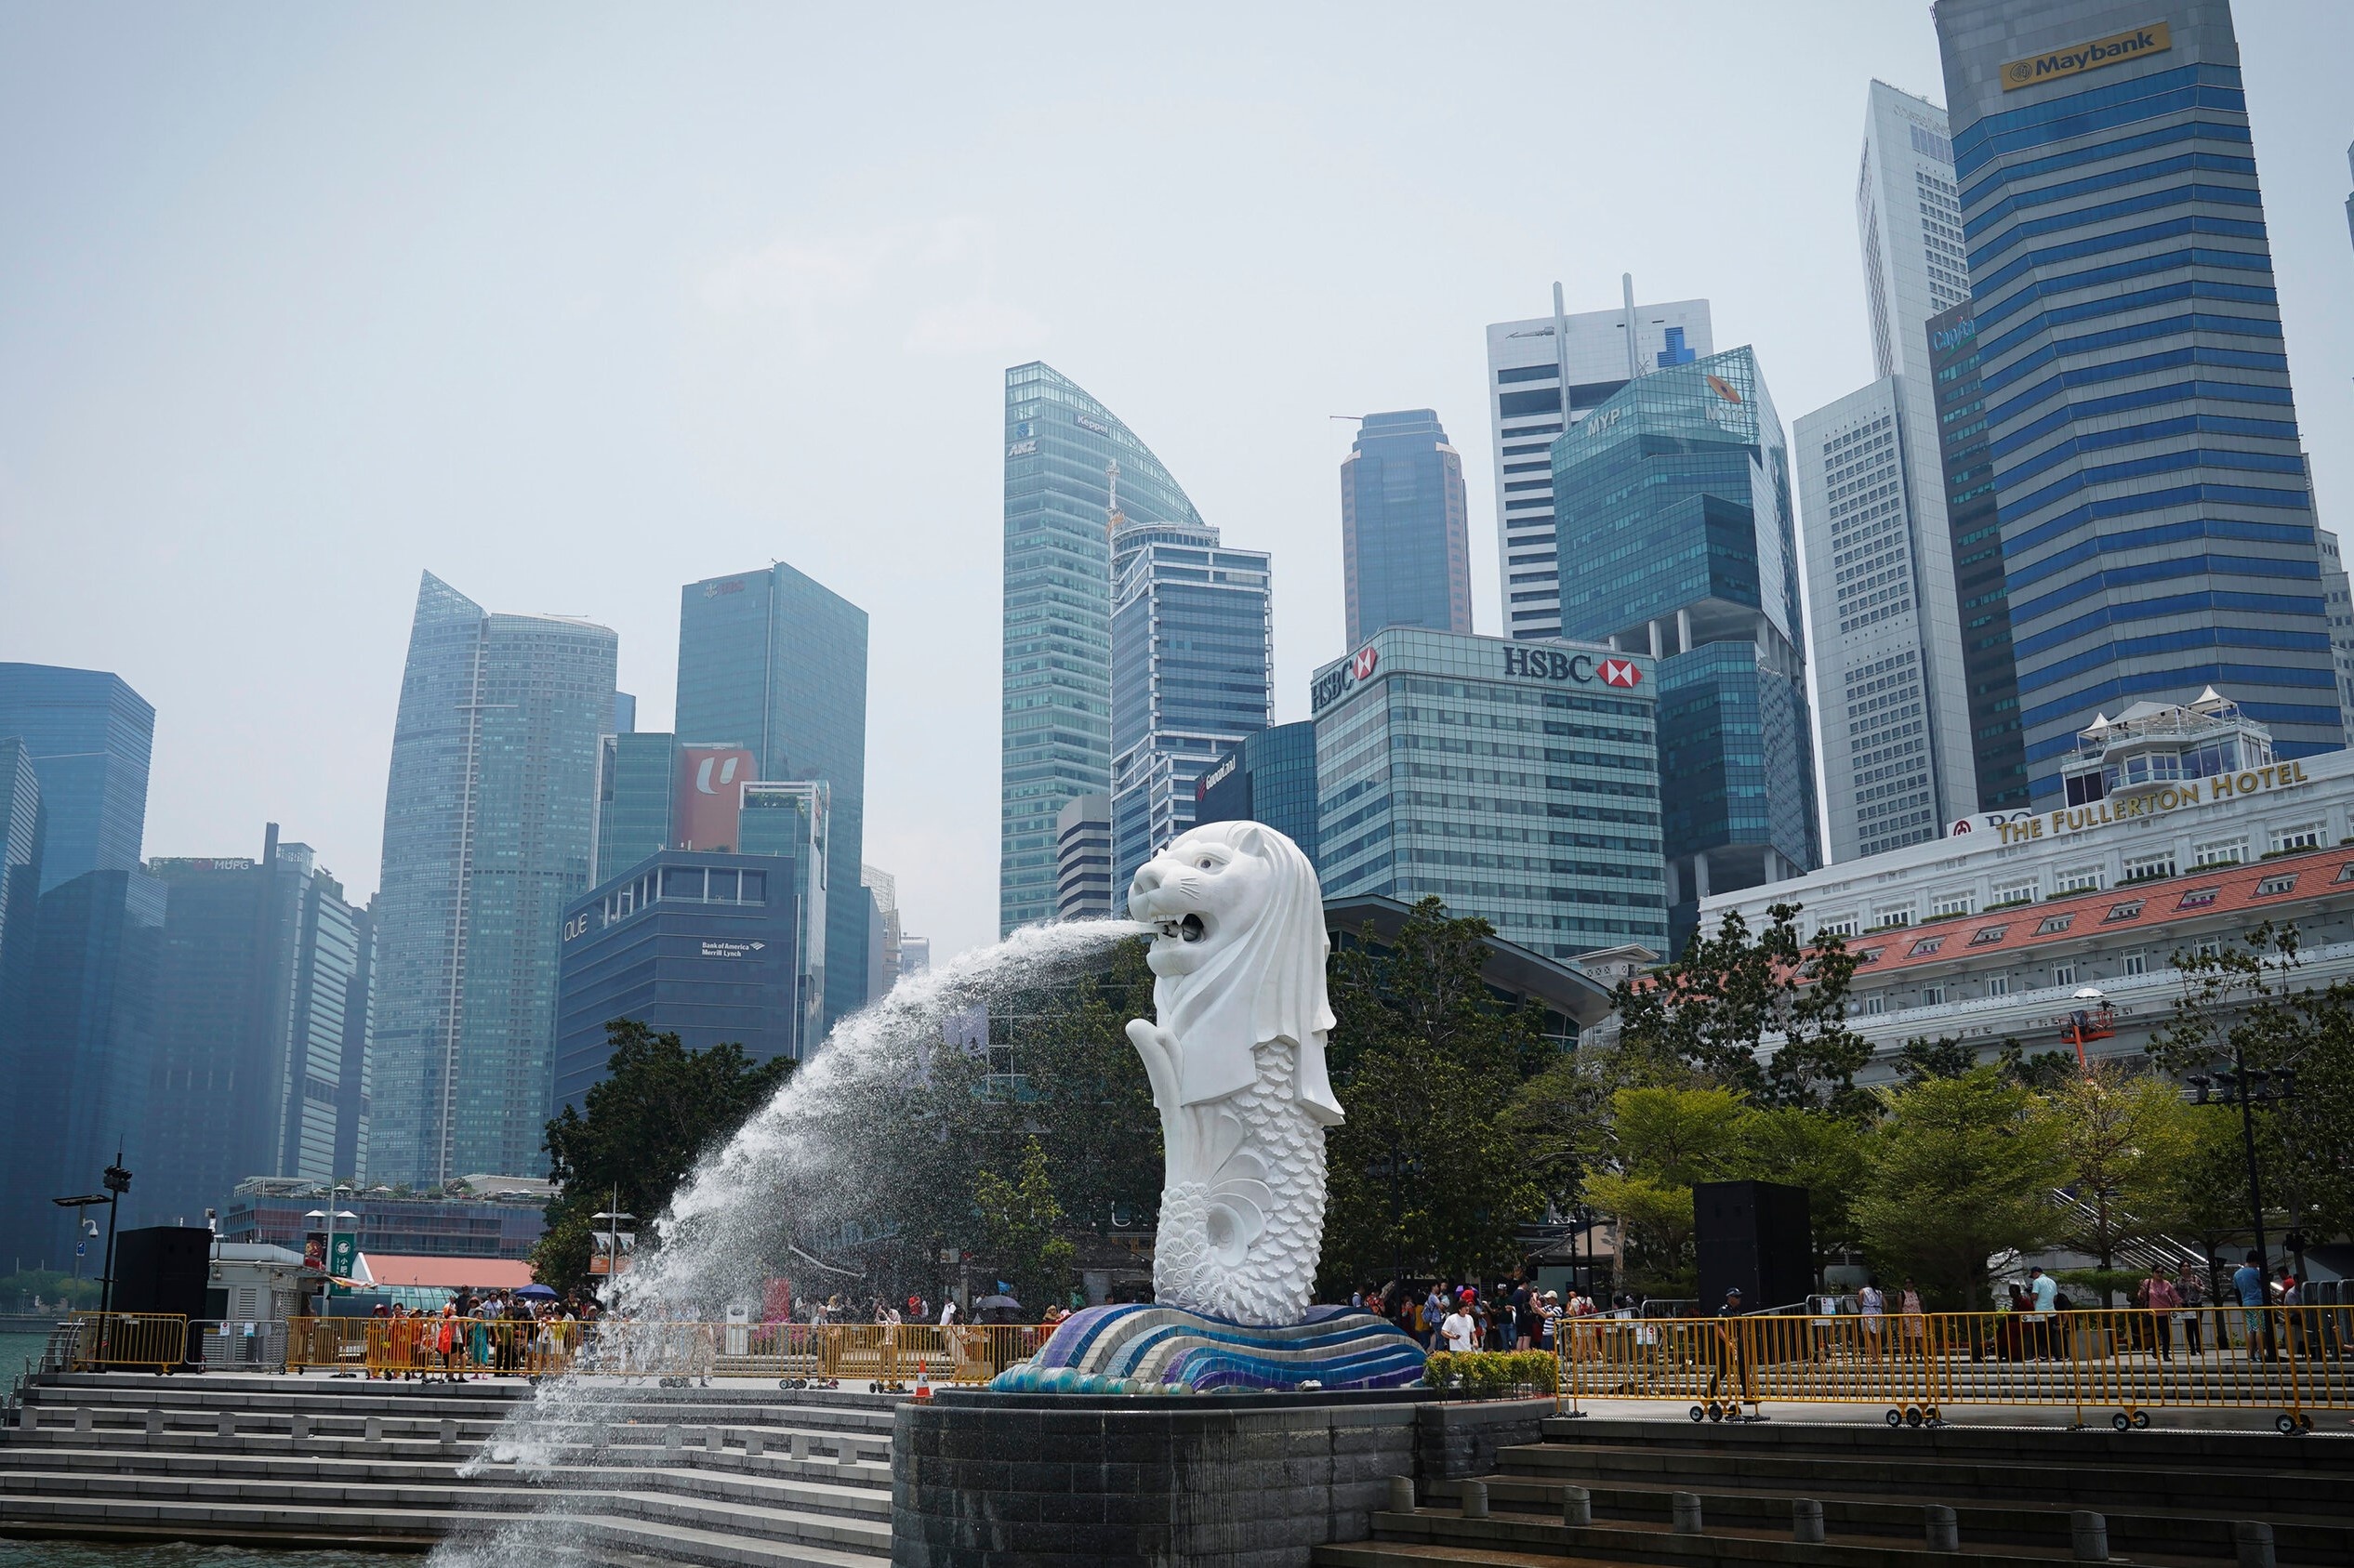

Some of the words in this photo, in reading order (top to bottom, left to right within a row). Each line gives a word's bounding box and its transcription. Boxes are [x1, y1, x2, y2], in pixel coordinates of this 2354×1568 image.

[2035, 31, 2156, 76] Maybank
[1077, 414, 1109, 435] Keppel
[1586, 407, 1622, 438] MYP
[1704, 403, 1746, 424] MYP
[1008, 440, 1038, 457] ANZ
[1502, 646, 1594, 684] HSBC
[1310, 659, 1355, 714] HSBC
[1996, 818, 2043, 845] THE
[2051, 783, 2200, 834] FULLERTON
[2211, 761, 2308, 800] HOTEL
[214, 860, 249, 870] MUFG
[564, 913, 588, 942] OUE
[725, 942, 749, 951] America
